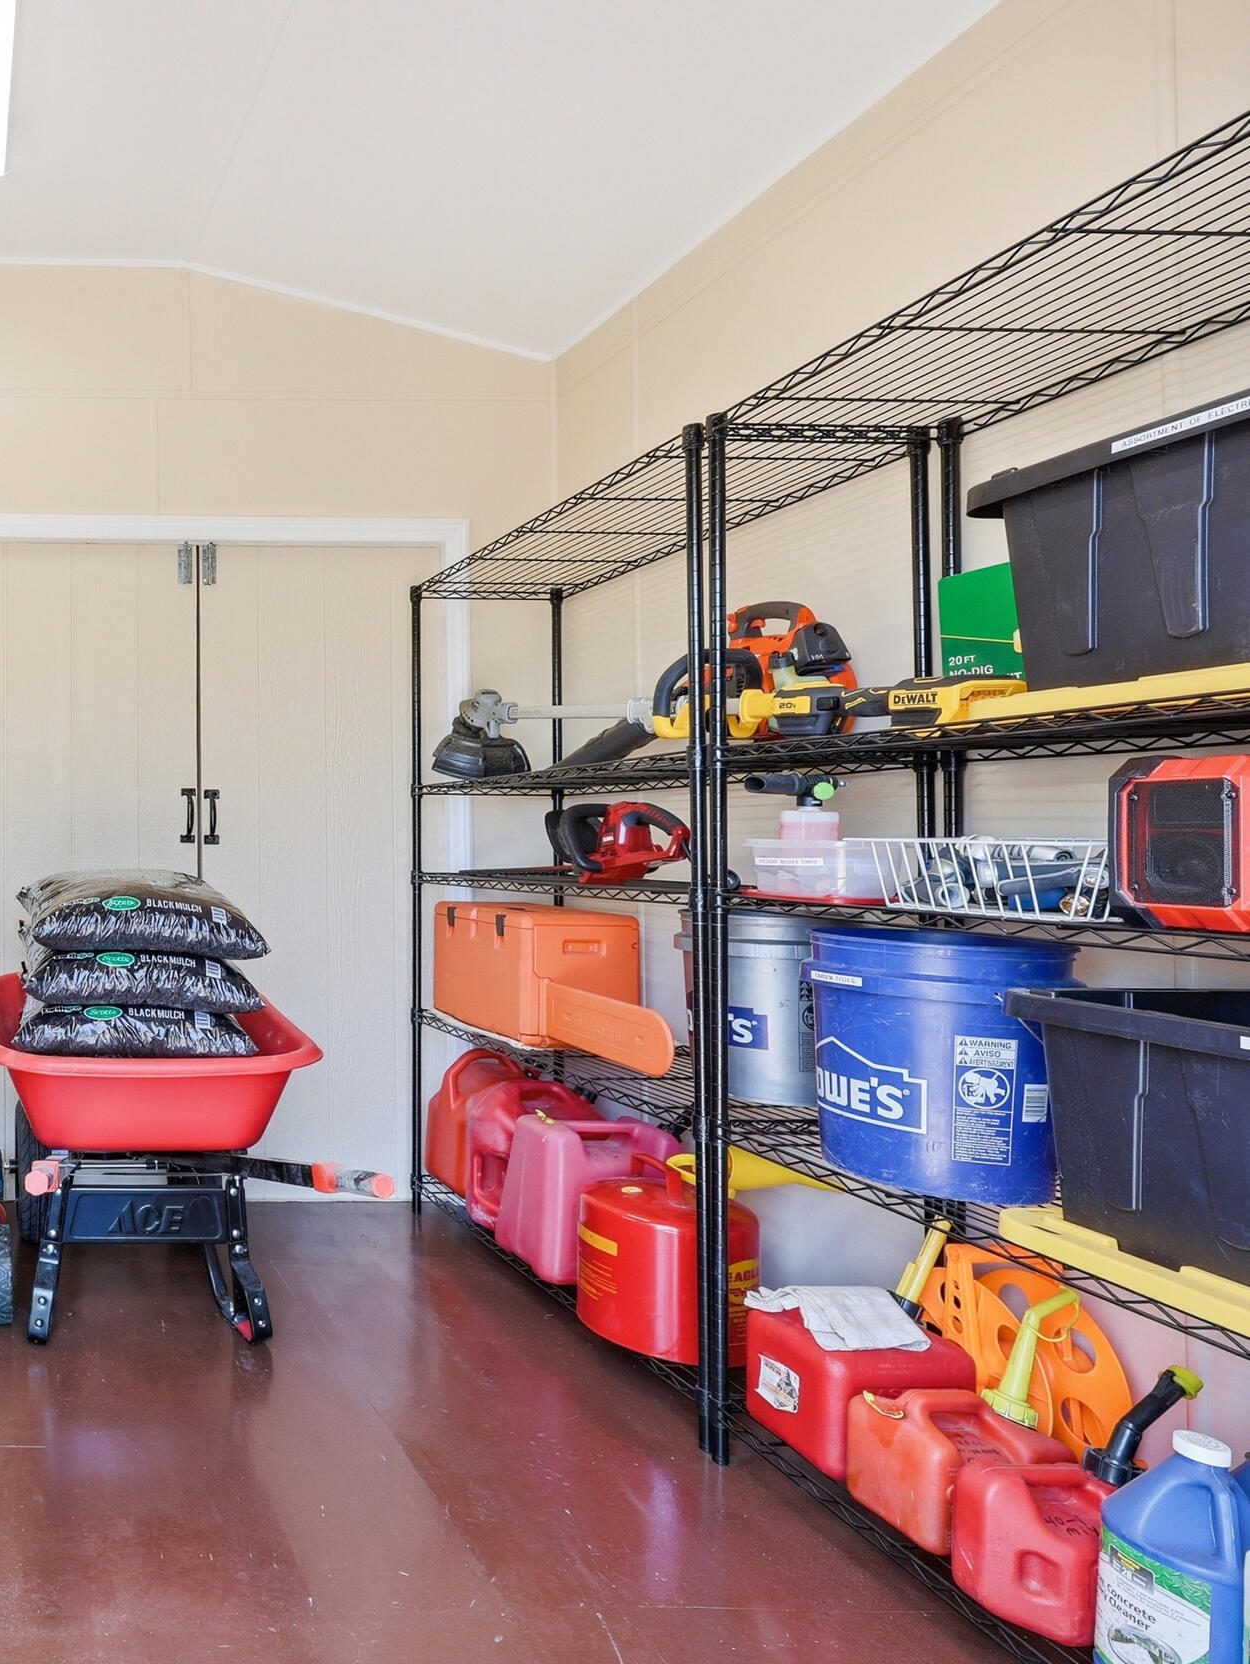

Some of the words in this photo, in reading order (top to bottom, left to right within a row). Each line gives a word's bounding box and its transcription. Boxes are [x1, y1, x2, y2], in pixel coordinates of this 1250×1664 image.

[1189, 412, 1205, 427] OF
[1207, 399, 1250, 423] ELECTR
[948, 655, 963, 666] 20
[964, 654, 976, 664] FT
[146, 899, 175, 910] BLACK
[175, 902, 203, 913] MULCH
[140, 954, 170, 963] BLACK
[170, 957, 196, 968] MULCH
[128, 1007, 157, 1017] BLACK
[157, 1009, 185, 1020] MULCH
[969, 1039, 1012, 1050] WARNING
[973, 1049, 1001, 1058] AVISO
[816, 1066, 904, 1120] OWE'S
[107, 1199, 185, 1234] ACE
[1106, 1583, 1157, 1625] Concrete
[1108, 1596, 1151, 1632] Cleaner
